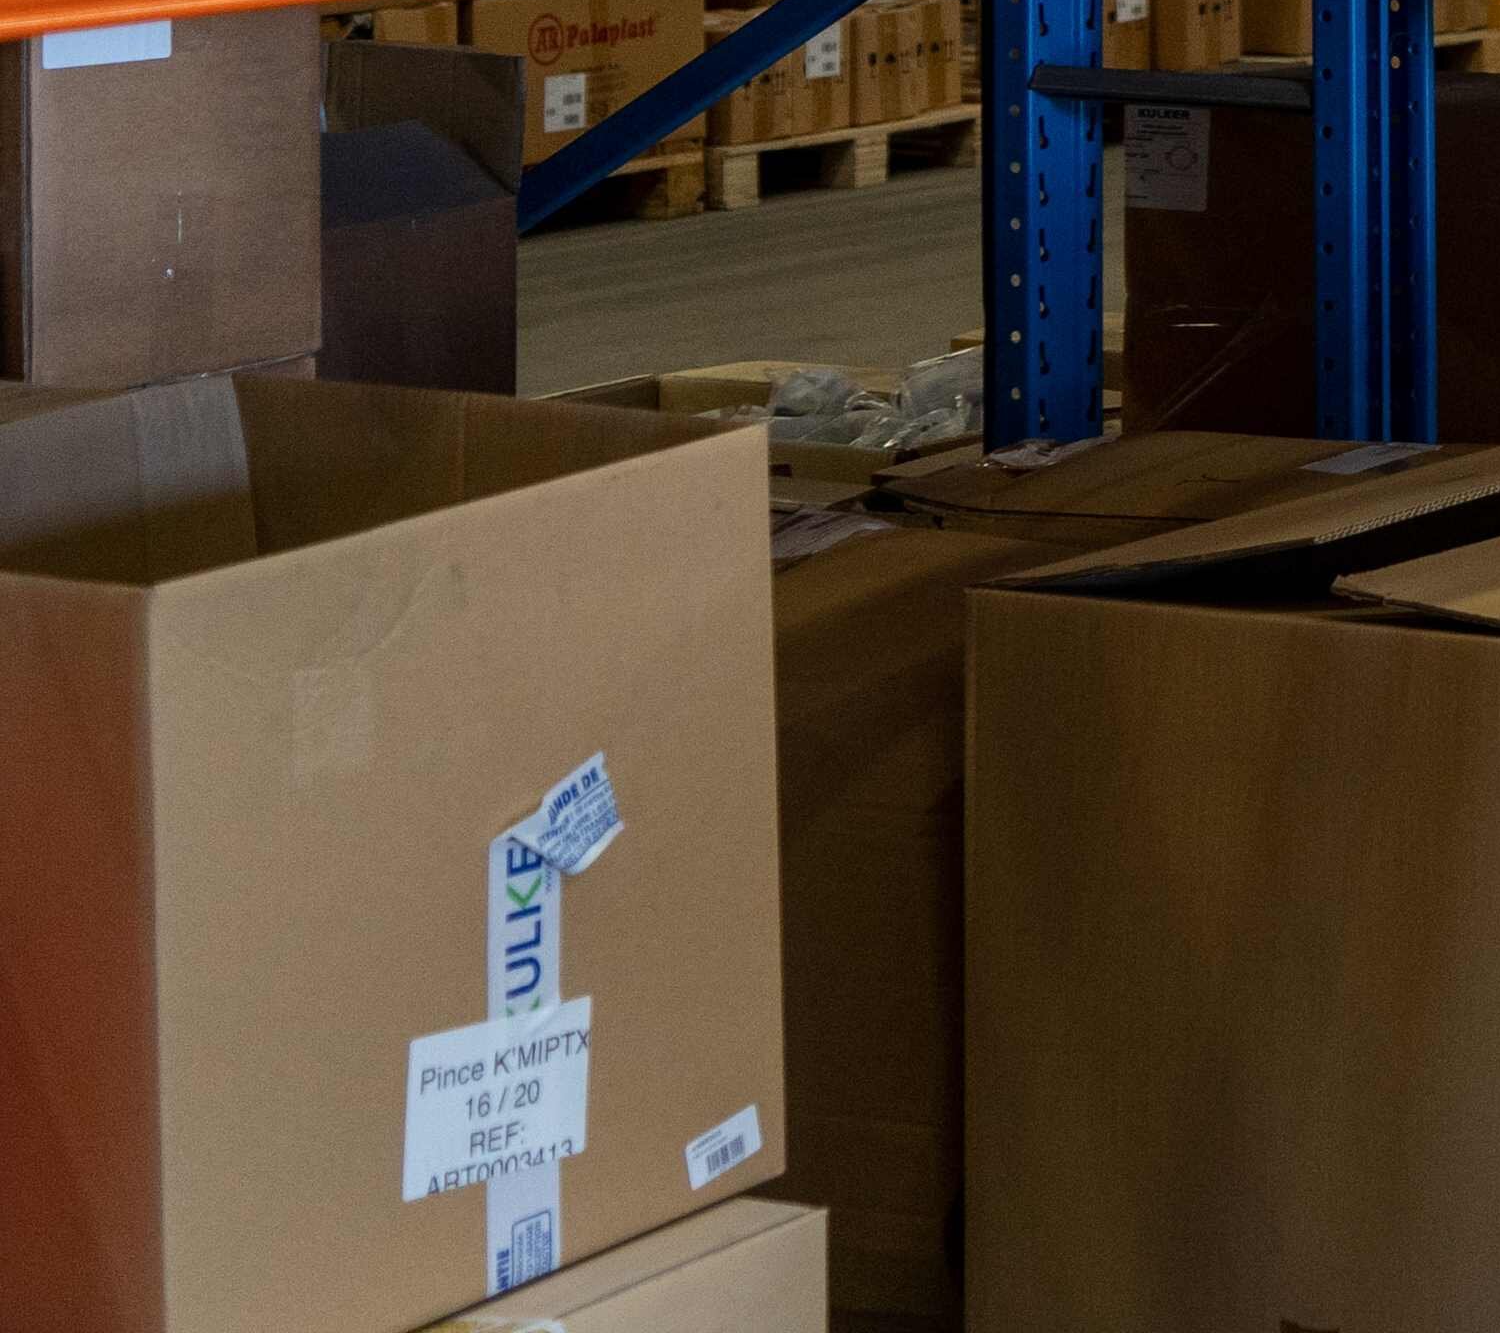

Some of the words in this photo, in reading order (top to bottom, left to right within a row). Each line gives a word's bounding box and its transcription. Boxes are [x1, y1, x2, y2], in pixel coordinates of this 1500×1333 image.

[581, 767, 600, 790] DE
[420, 1061, 485, 1095] Pince
[466, 1092, 491, 1120] 16
[497, 1086, 508, 1113] /
[514, 1079, 540, 1109] 20
[469, 1120, 525, 1158] REF:
